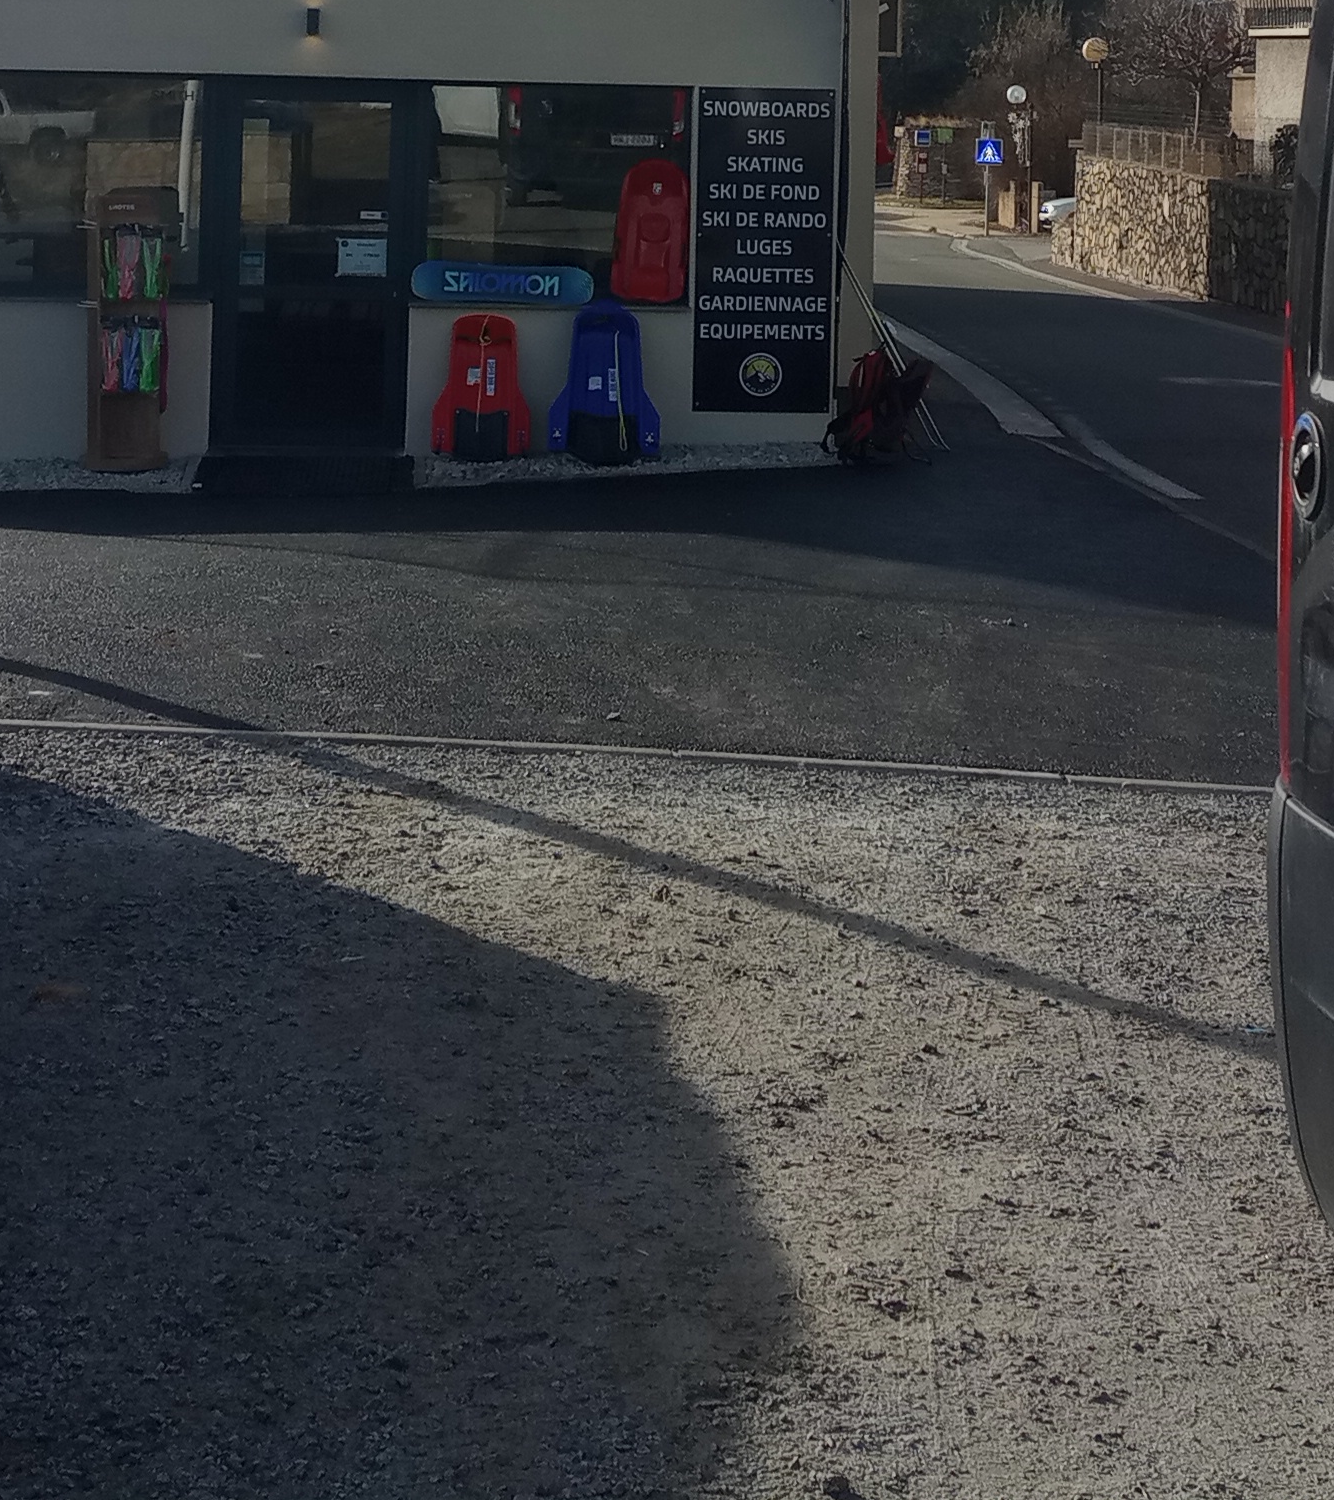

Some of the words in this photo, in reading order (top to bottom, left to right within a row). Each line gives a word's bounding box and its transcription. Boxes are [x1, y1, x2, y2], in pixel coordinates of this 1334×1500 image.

[703, 101, 830, 118] SNOWBOARDS
[747, 129, 786, 145] SKIS
[727, 156, 804, 173] SKATING
[709, 184, 736, 199] SKI
[743, 184, 766, 199] DE
[771, 185, 820, 200] FOND
[702, 211, 730, 227] SKI
[736, 212, 759, 227] DE
[764, 212, 826, 228] RANDO
[736, 239, 792, 255] LUGES
[712, 267, 814, 284] RAQUETTES
[698, 295, 827, 312] GARDIENNAGE
[700, 323, 825, 340] EQUIPEMENTS
